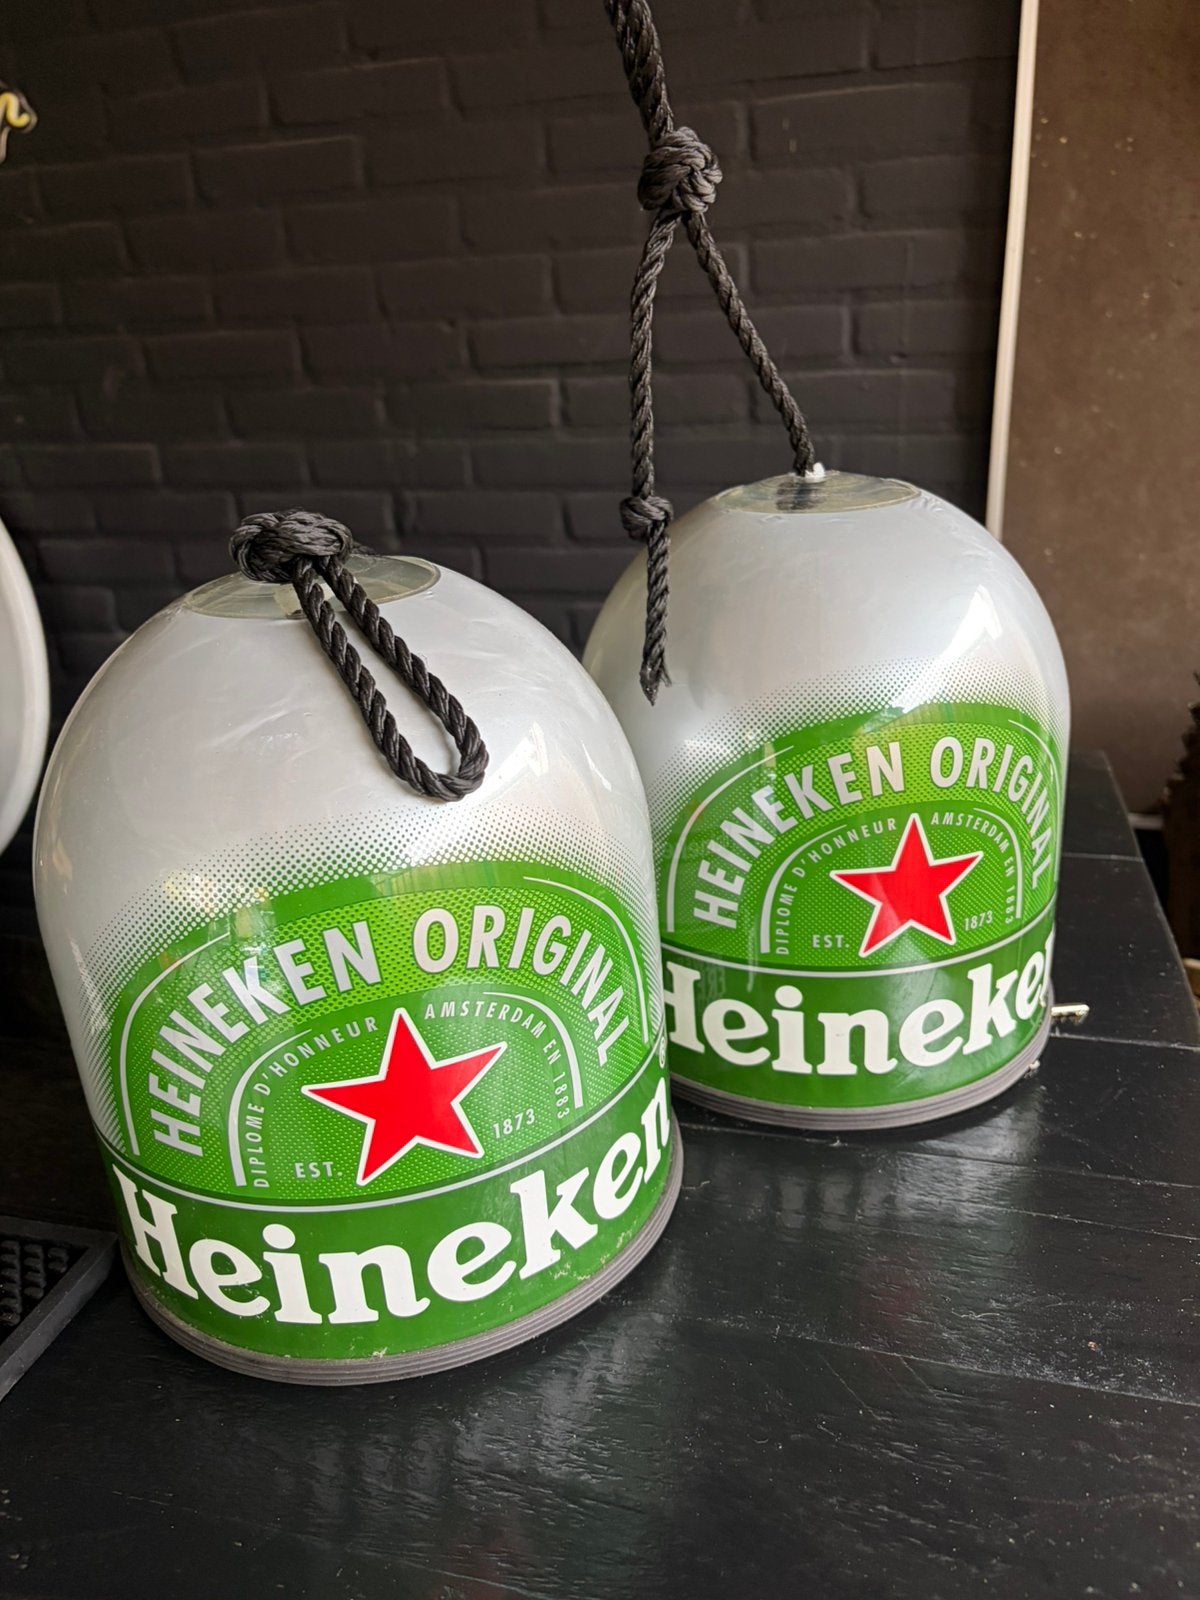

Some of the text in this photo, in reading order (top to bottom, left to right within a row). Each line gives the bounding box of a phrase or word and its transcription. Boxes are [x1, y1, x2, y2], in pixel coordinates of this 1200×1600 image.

[693, 736, 1052, 929] HEINEKEN ORIGINAL
[775, 812, 1015, 955] DIPLOME D'HONNEUR AMSTERDAM EN 1883
[812, 911, 993, 948] EST. 1873
[149, 905, 630, 1157] HEINEKEN ORIGINAL
[245, 1001, 570, 1188] DIPLOME D'HONNEUR AMSTERDAM EN 1883
[112, 1077, 670, 1325] Heineken
[295, 1108, 535, 1178] EST. 1873
